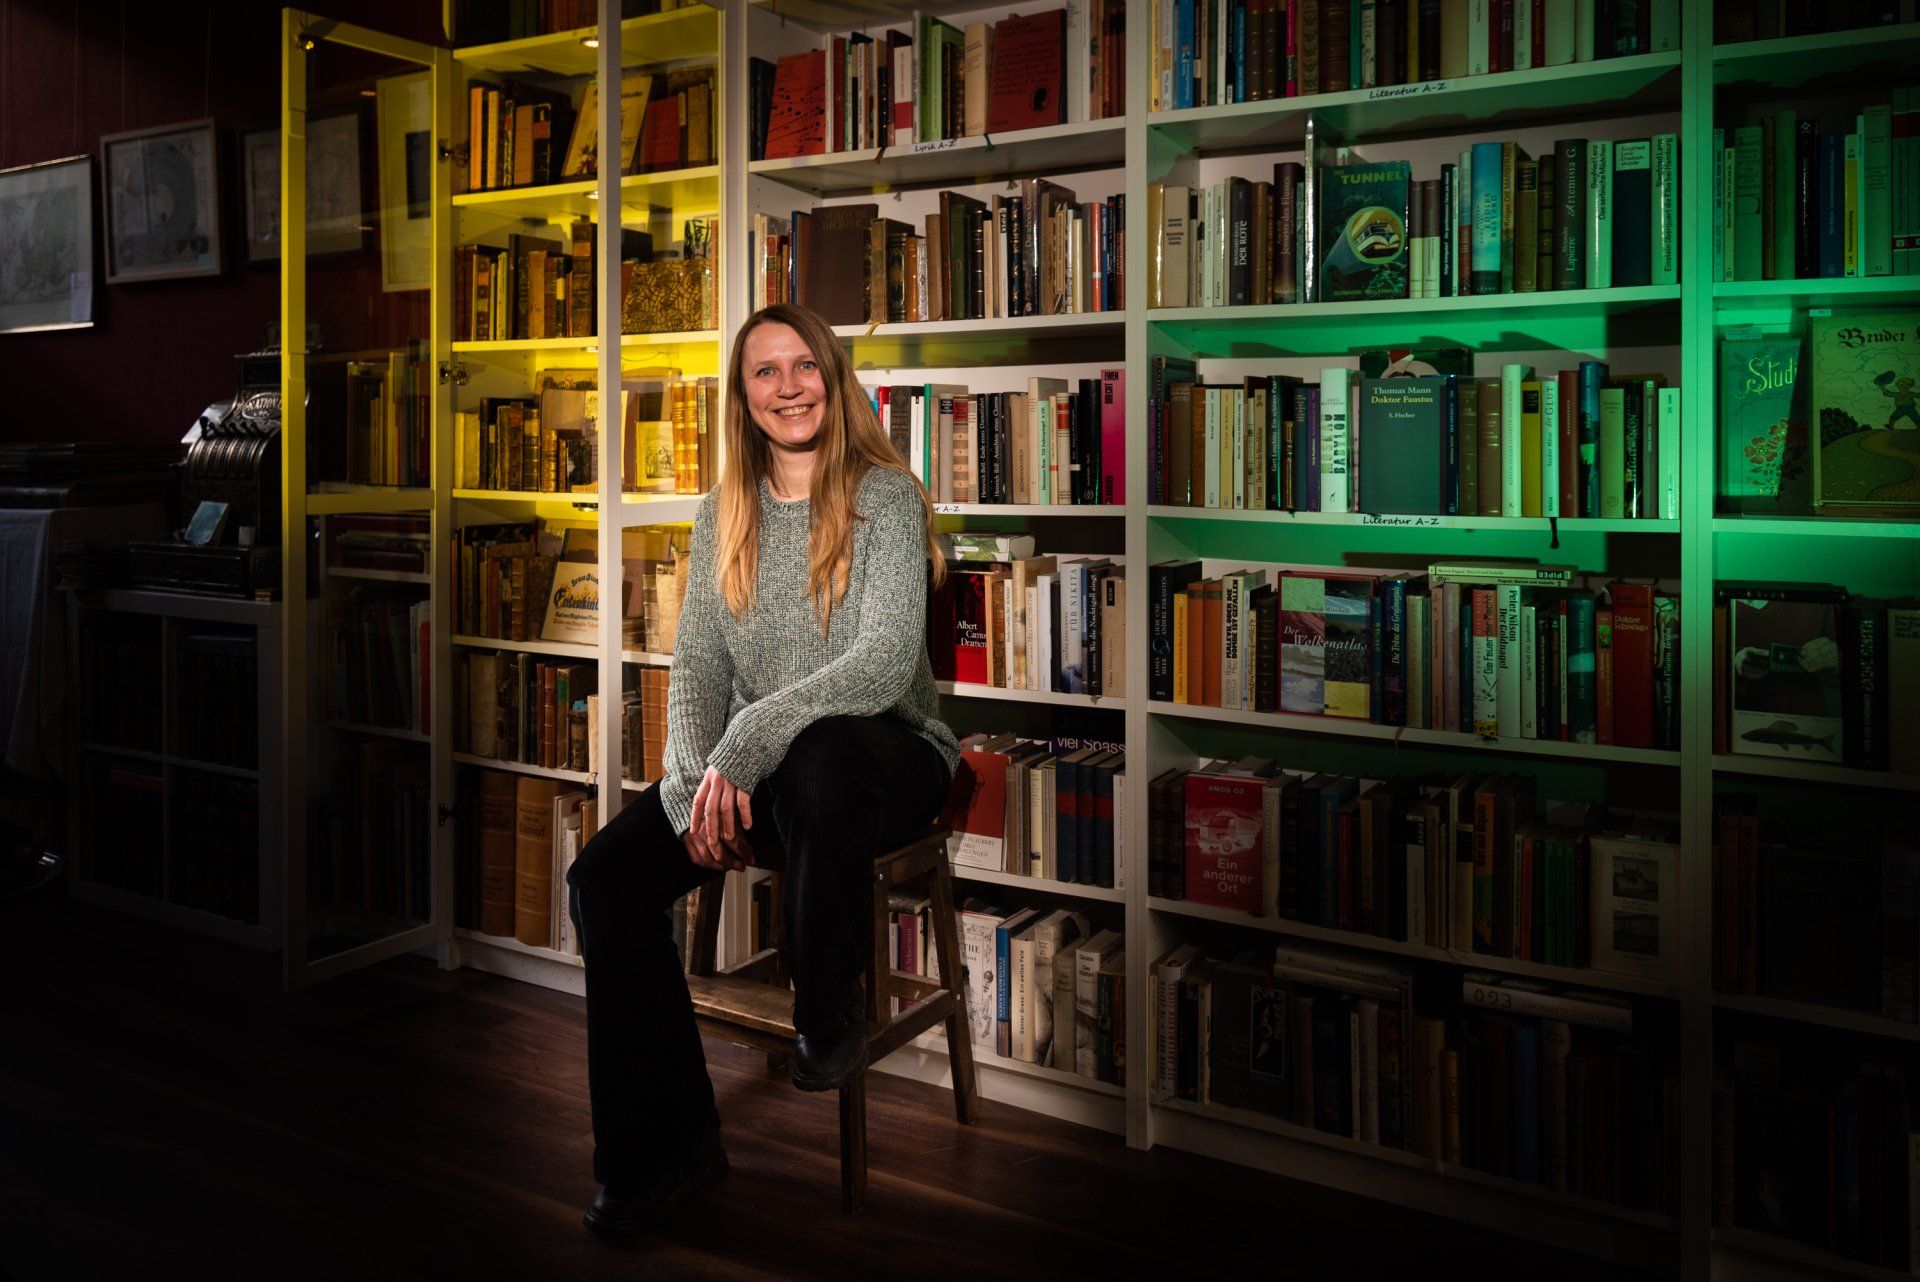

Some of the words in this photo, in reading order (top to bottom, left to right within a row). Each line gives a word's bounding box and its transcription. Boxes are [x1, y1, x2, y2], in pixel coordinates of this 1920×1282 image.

[1369, 86, 1418, 99] Literatur
[1422, 82, 1447, 93] A-Z
[915, 143, 936, 153] Lyrik
[938, 140, 956, 149] A-Z
[1562, 145, 1576, 158] G.
[1665, 138, 1673, 170] Hamburg
[1340, 168, 1403, 185] TUNNEL
[1665, 172, 1673, 182] bei
[1281, 176, 1290, 206] Flusses
[1562, 162, 1576, 217] Artemisia
[1665, 182, 1673, 197] Elbe
[1665, 198, 1673, 208] die
[1281, 208, 1290, 222] des
[1281, 223, 1290, 256] Jenseits
[1665, 244, 1673, 272] Einstein
[1837, 326, 1905, 348] Bruder
[1373, 386, 1405, 395] Thomas
[1407, 386, 1431, 394] Mann
[1371, 396, 1401, 404] Doktor
[1403, 396, 1433, 404] Faustus
[979, 431, 987, 444] einer
[1333, 413, 1346, 474] BABYLON
[979, 446, 987, 459] Ende
[979, 462, 987, 475] Böll
[979, 476, 987, 498] Heinrich
[1363, 516, 1412, 525] Literatur
[1415, 517, 1439, 526] A-Z
[1537, 571, 1562, 579] PIPER
[1069, 569, 1077, 606] NIKITA
[1509, 589, 1518, 612] Peter
[1069, 612, 1077, 631] FÜR
[1498, 608, 1508, 623] Der
[1614, 615, 1641, 623] Doktor
[956, 620, 977, 630] Albert
[1283, 625, 1300, 635] Der
[1484, 624, 1494, 636] der
[1509, 614, 1518, 642] Nilson
[1614, 622, 1649, 631] Schiwago
[965, 630, 987, 640] Camus
[960, 637, 987, 648] Dramen
[1090, 641, 1097, 652] Wo
[1294, 634, 1367, 651] Wolkenatlas
[1498, 624, 1508, 669] Goldnagel
[1484, 639, 1494, 660] Feuer
[1392, 653, 1400, 664] Die
[1484, 662, 1494, 674] Die
[1057, 736, 1078, 749] viel
[1208, 785, 1231, 793] AMOS
[1234, 787, 1245, 795] OZ
[1218, 857, 1238, 870] Ein
[1203, 870, 1253, 884] anderer
[1218, 881, 1238, 894] Ort
[1473, 988, 1511, 1009] EGO
